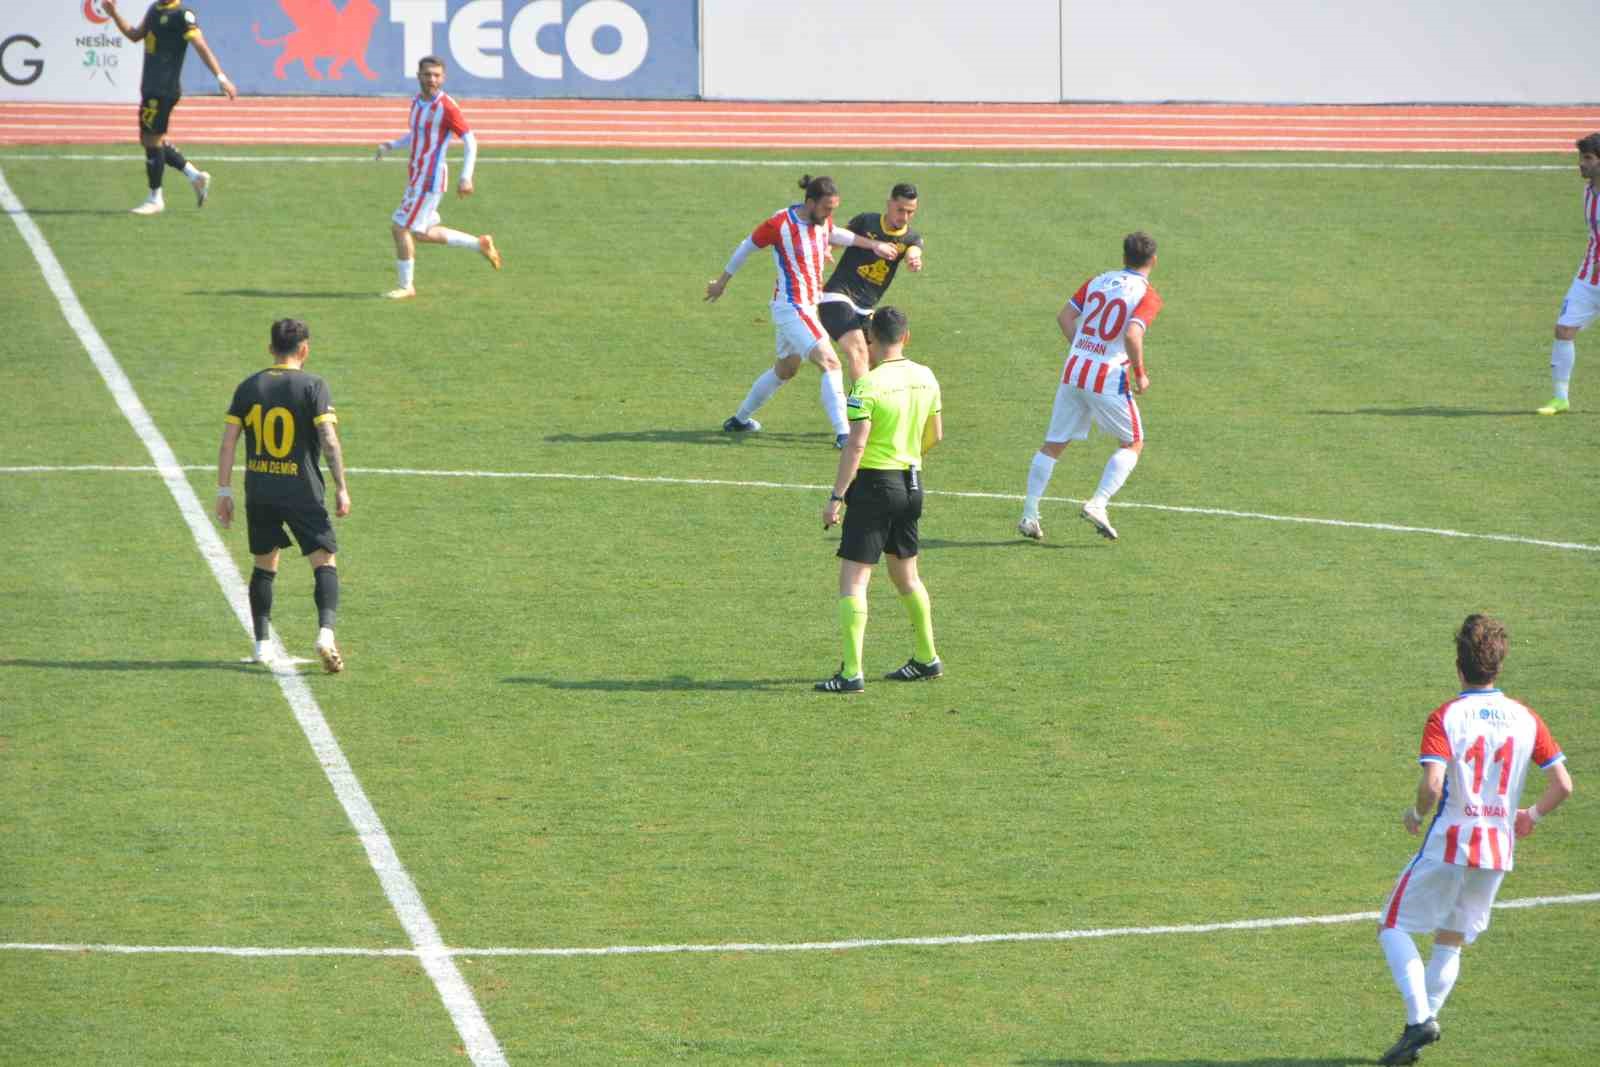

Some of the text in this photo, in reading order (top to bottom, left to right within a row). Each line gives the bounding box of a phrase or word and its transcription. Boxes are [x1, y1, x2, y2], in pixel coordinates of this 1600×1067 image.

[0, 34, 44, 86] G
[390, 0, 649, 80] TECO
[1082, 291, 1127, 341] 20
[245, 404, 295, 458] 10
[1465, 735, 1515, 795] 11
